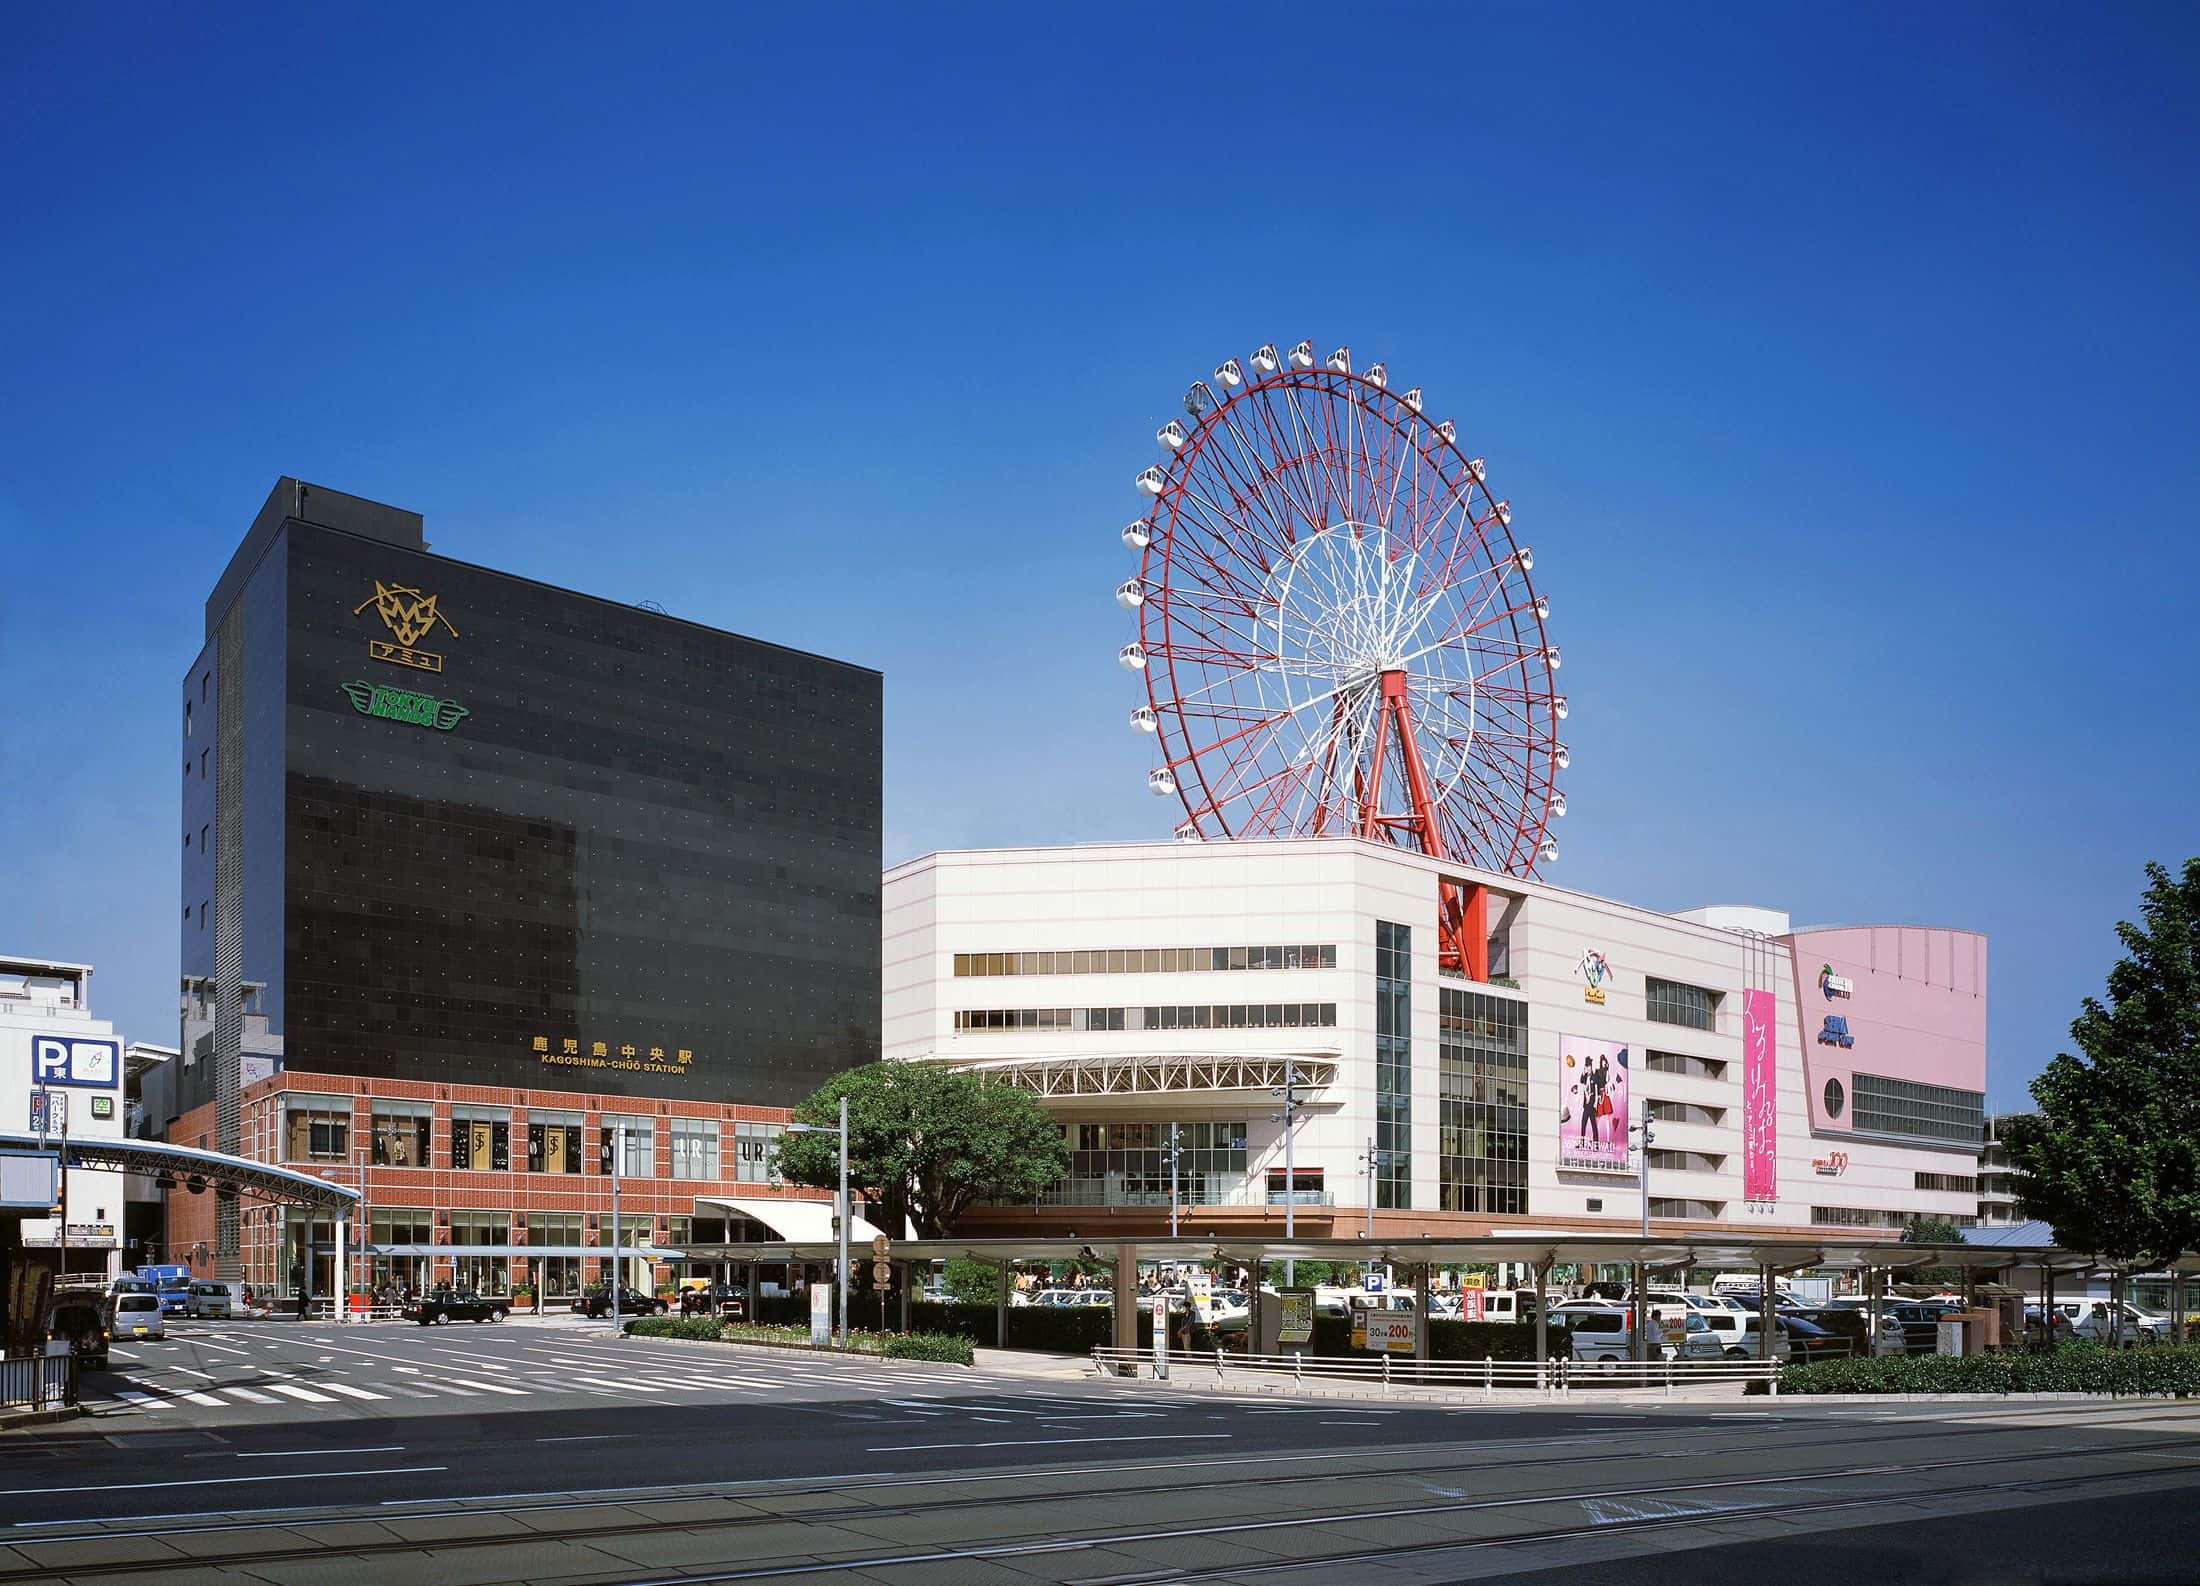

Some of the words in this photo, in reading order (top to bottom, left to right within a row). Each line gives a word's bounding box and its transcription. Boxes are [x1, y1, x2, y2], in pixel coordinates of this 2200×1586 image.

[381, 645, 431, 667] アミュ
[375, 688, 437, 713] TOKYU
[372, 702, 433, 727] HANDS
[38, 1039, 68, 1078] P
[532, 1035, 693, 1065] 鹿児島中央駅
[53, 1067, 67, 1079] 東
[643, 1062, 686, 1075] STATION
[95, 1099, 109, 1112] 空
[679, 1138, 703, 1159] UR
[742, 1142, 764, 1162] UR
[1367, 1276, 1380, 1290] P
[1388, 1324, 1409, 1338] 200
